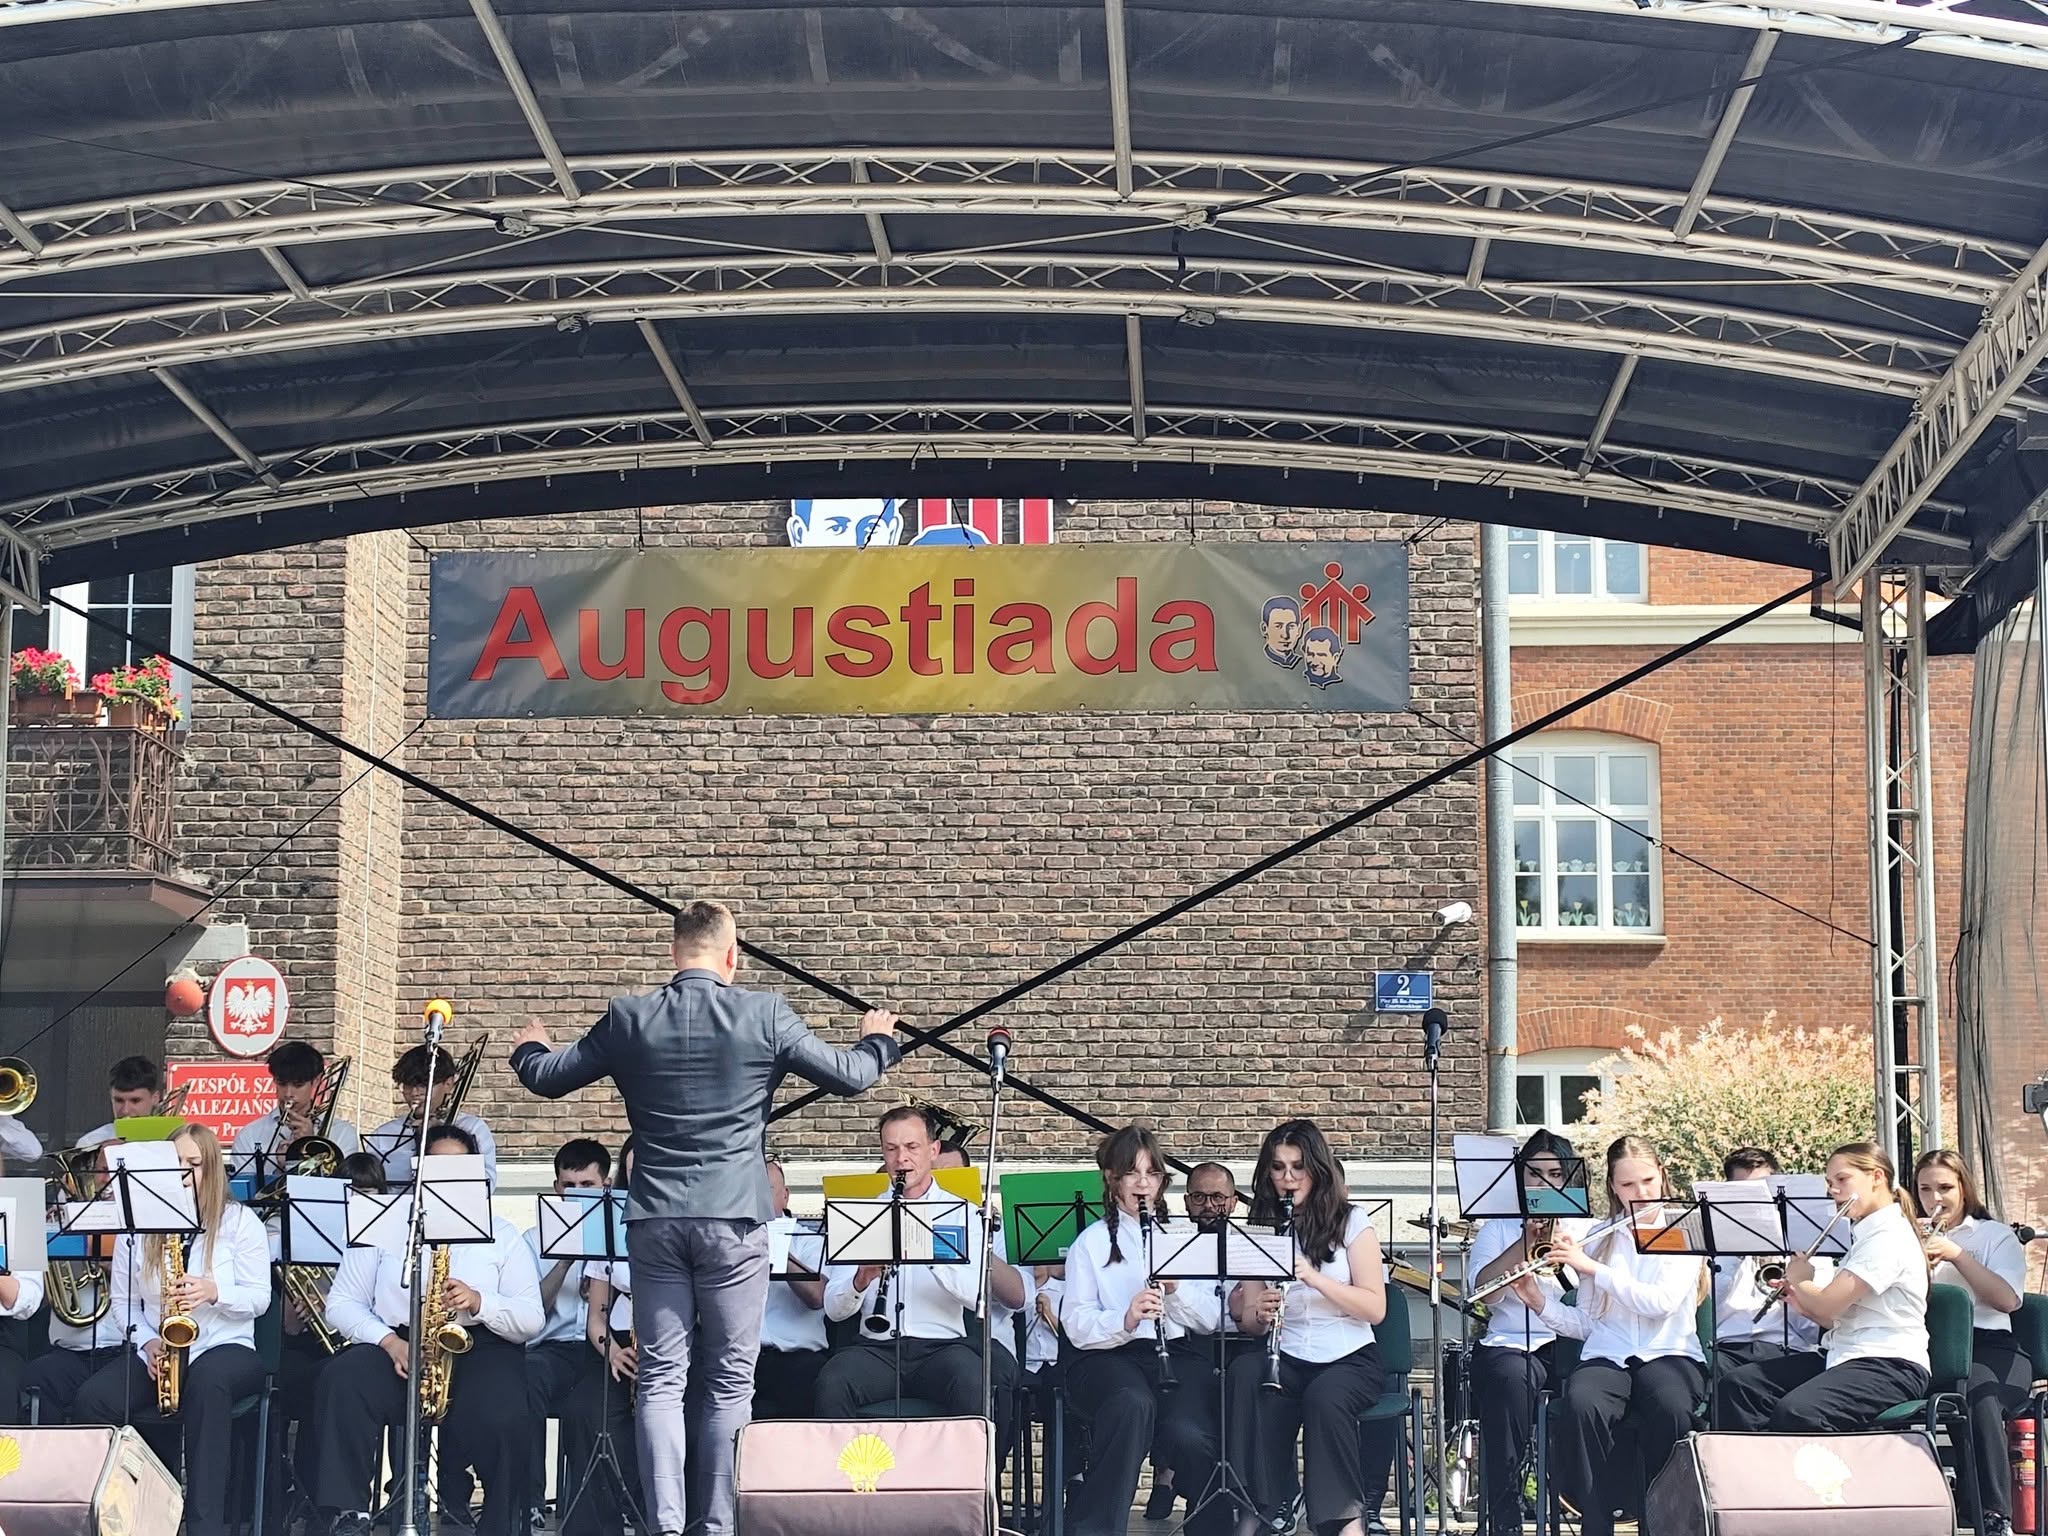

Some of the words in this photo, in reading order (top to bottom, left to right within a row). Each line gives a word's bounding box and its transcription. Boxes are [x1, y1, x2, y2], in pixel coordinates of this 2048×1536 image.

[468, 576, 1219, 704] Augustiada
[1397, 975, 1410, 995] 2
[187, 1073, 250, 1094] ZESPÓŁ
[253, 1077, 276, 1094] SZ
